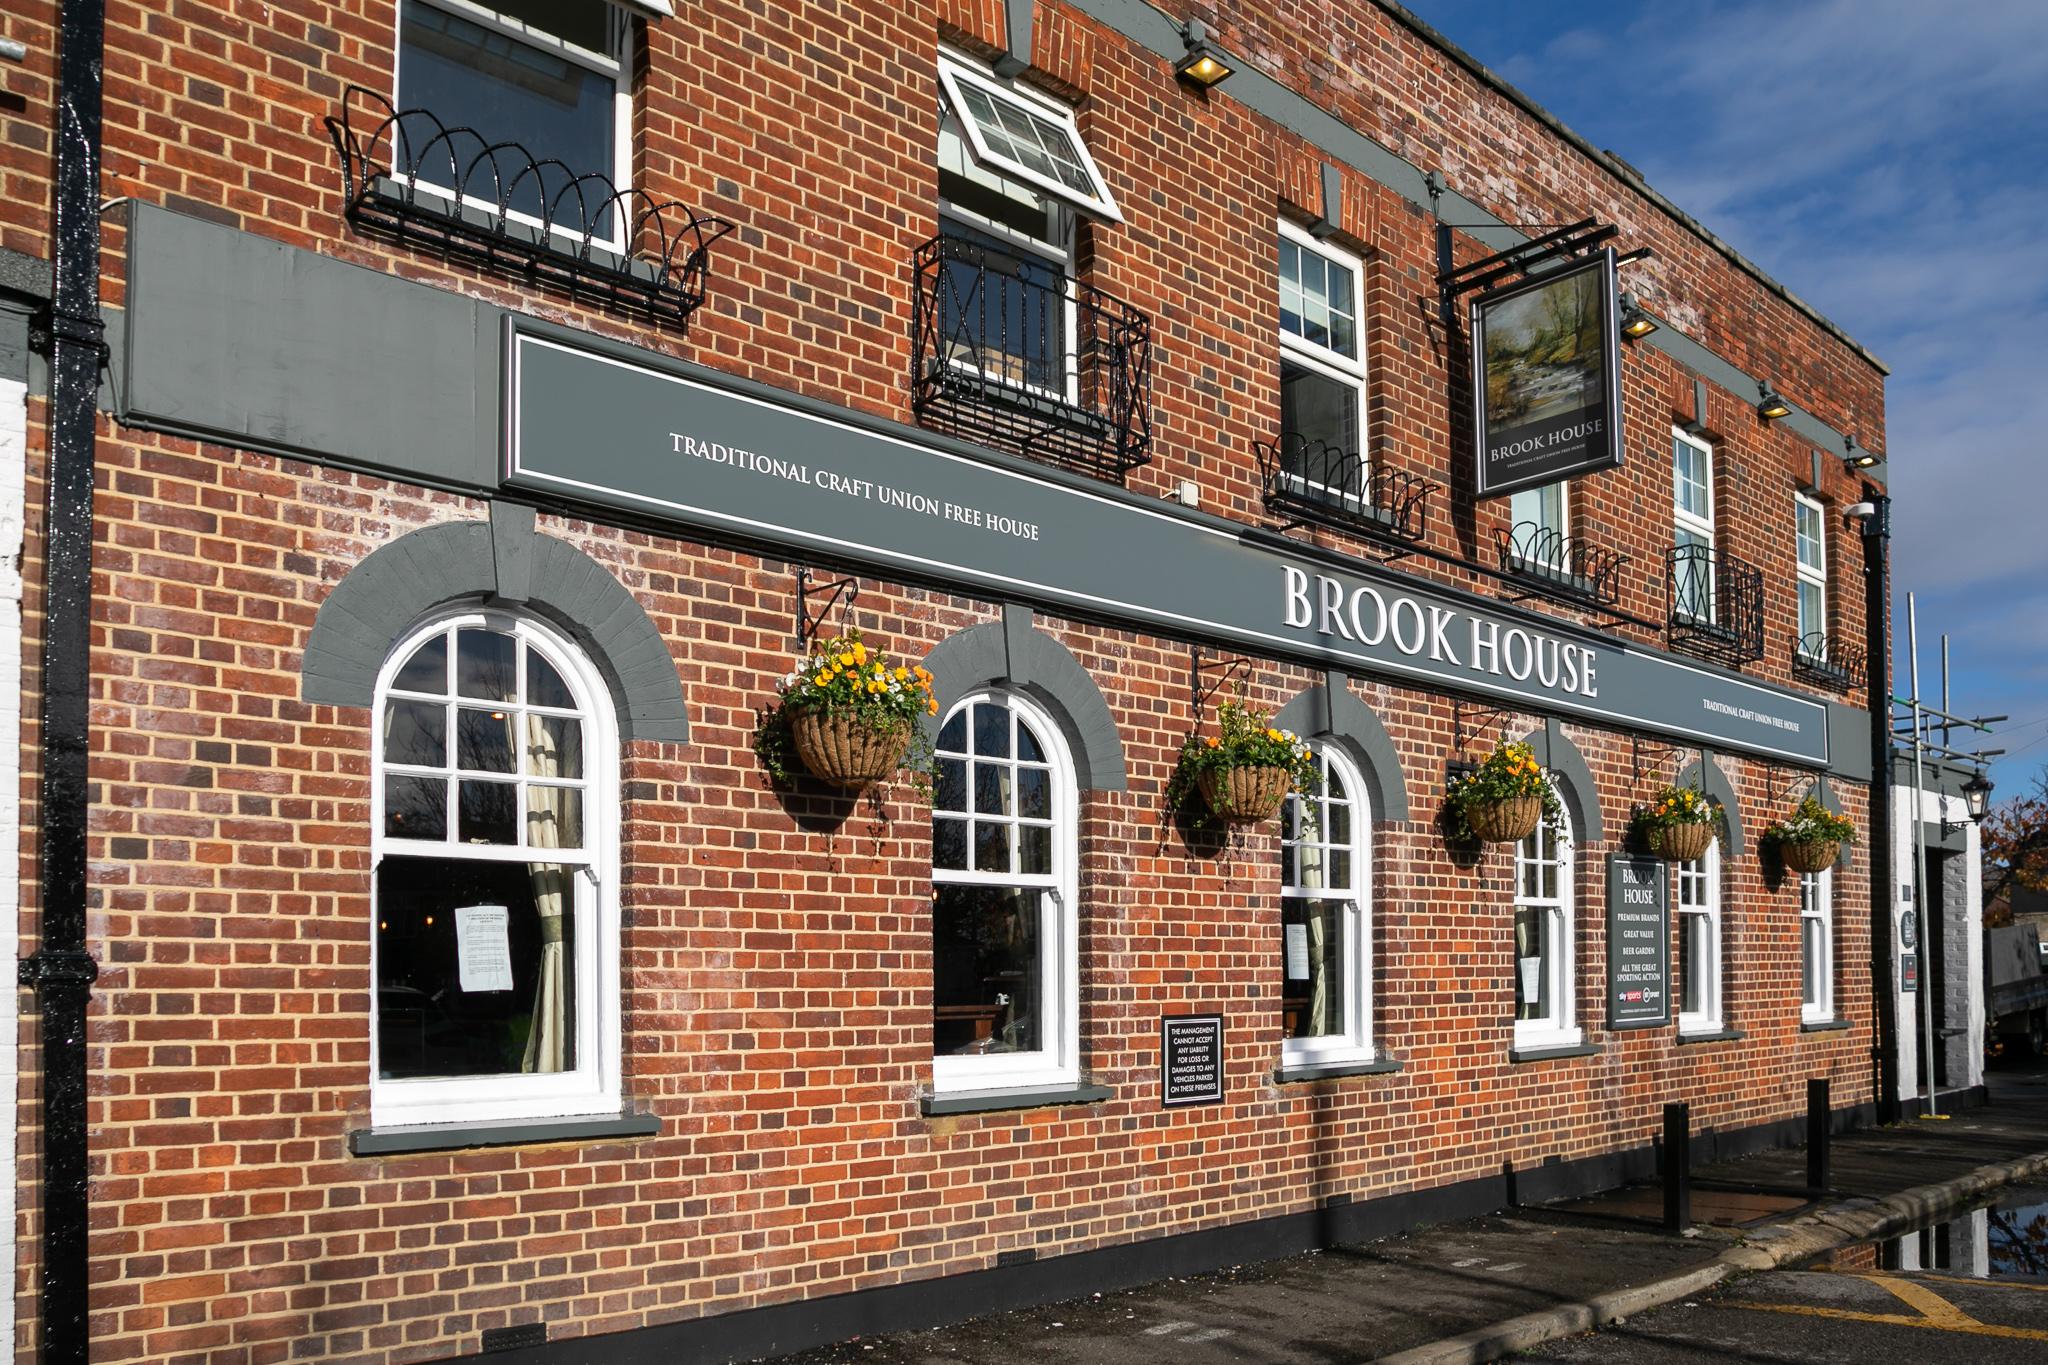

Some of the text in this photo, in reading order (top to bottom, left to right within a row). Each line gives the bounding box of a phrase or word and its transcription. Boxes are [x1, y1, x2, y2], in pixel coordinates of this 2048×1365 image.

[1490, 418, 1603, 462] BROOK HOUSE
[669, 432, 1040, 542] TRADITIONAL CRAFT UNION FREE HOUSE
[1279, 564, 1598, 698] BROOK HOUSE
[1702, 698, 1800, 733] TRADITIONAL CRAFT UNION FREE HOUSE
[1622, 868, 1655, 885] BROOK
[1623, 888, 1654, 905] HOUSE
[1617, 913, 1660, 922] PREMIUM BRANDS
[1623, 930, 1654, 939] GREAT VALUE
[1622, 946, 1655, 955] BEER GARDEN
[1621, 963, 1657, 972] ALL THE GREAT
[1616, 972, 1661, 982] SPORTING ACTION
[1171, 1026, 1215, 1036] THE MANAGEMENT
[1173, 1036, 1213, 1045] CANNOT ACCEPT
[1189, 1046, 1209, 1054] LIABILITY
[1201, 1055, 1210, 1063] OR
[1171, 1065, 1196, 1074] DAMAGES
[1173, 1073, 1214, 1083] VEHICLES PARKED
[1170, 1086, 1180, 1094] ON
[1194, 1082, 1217, 1092] PREMISES
